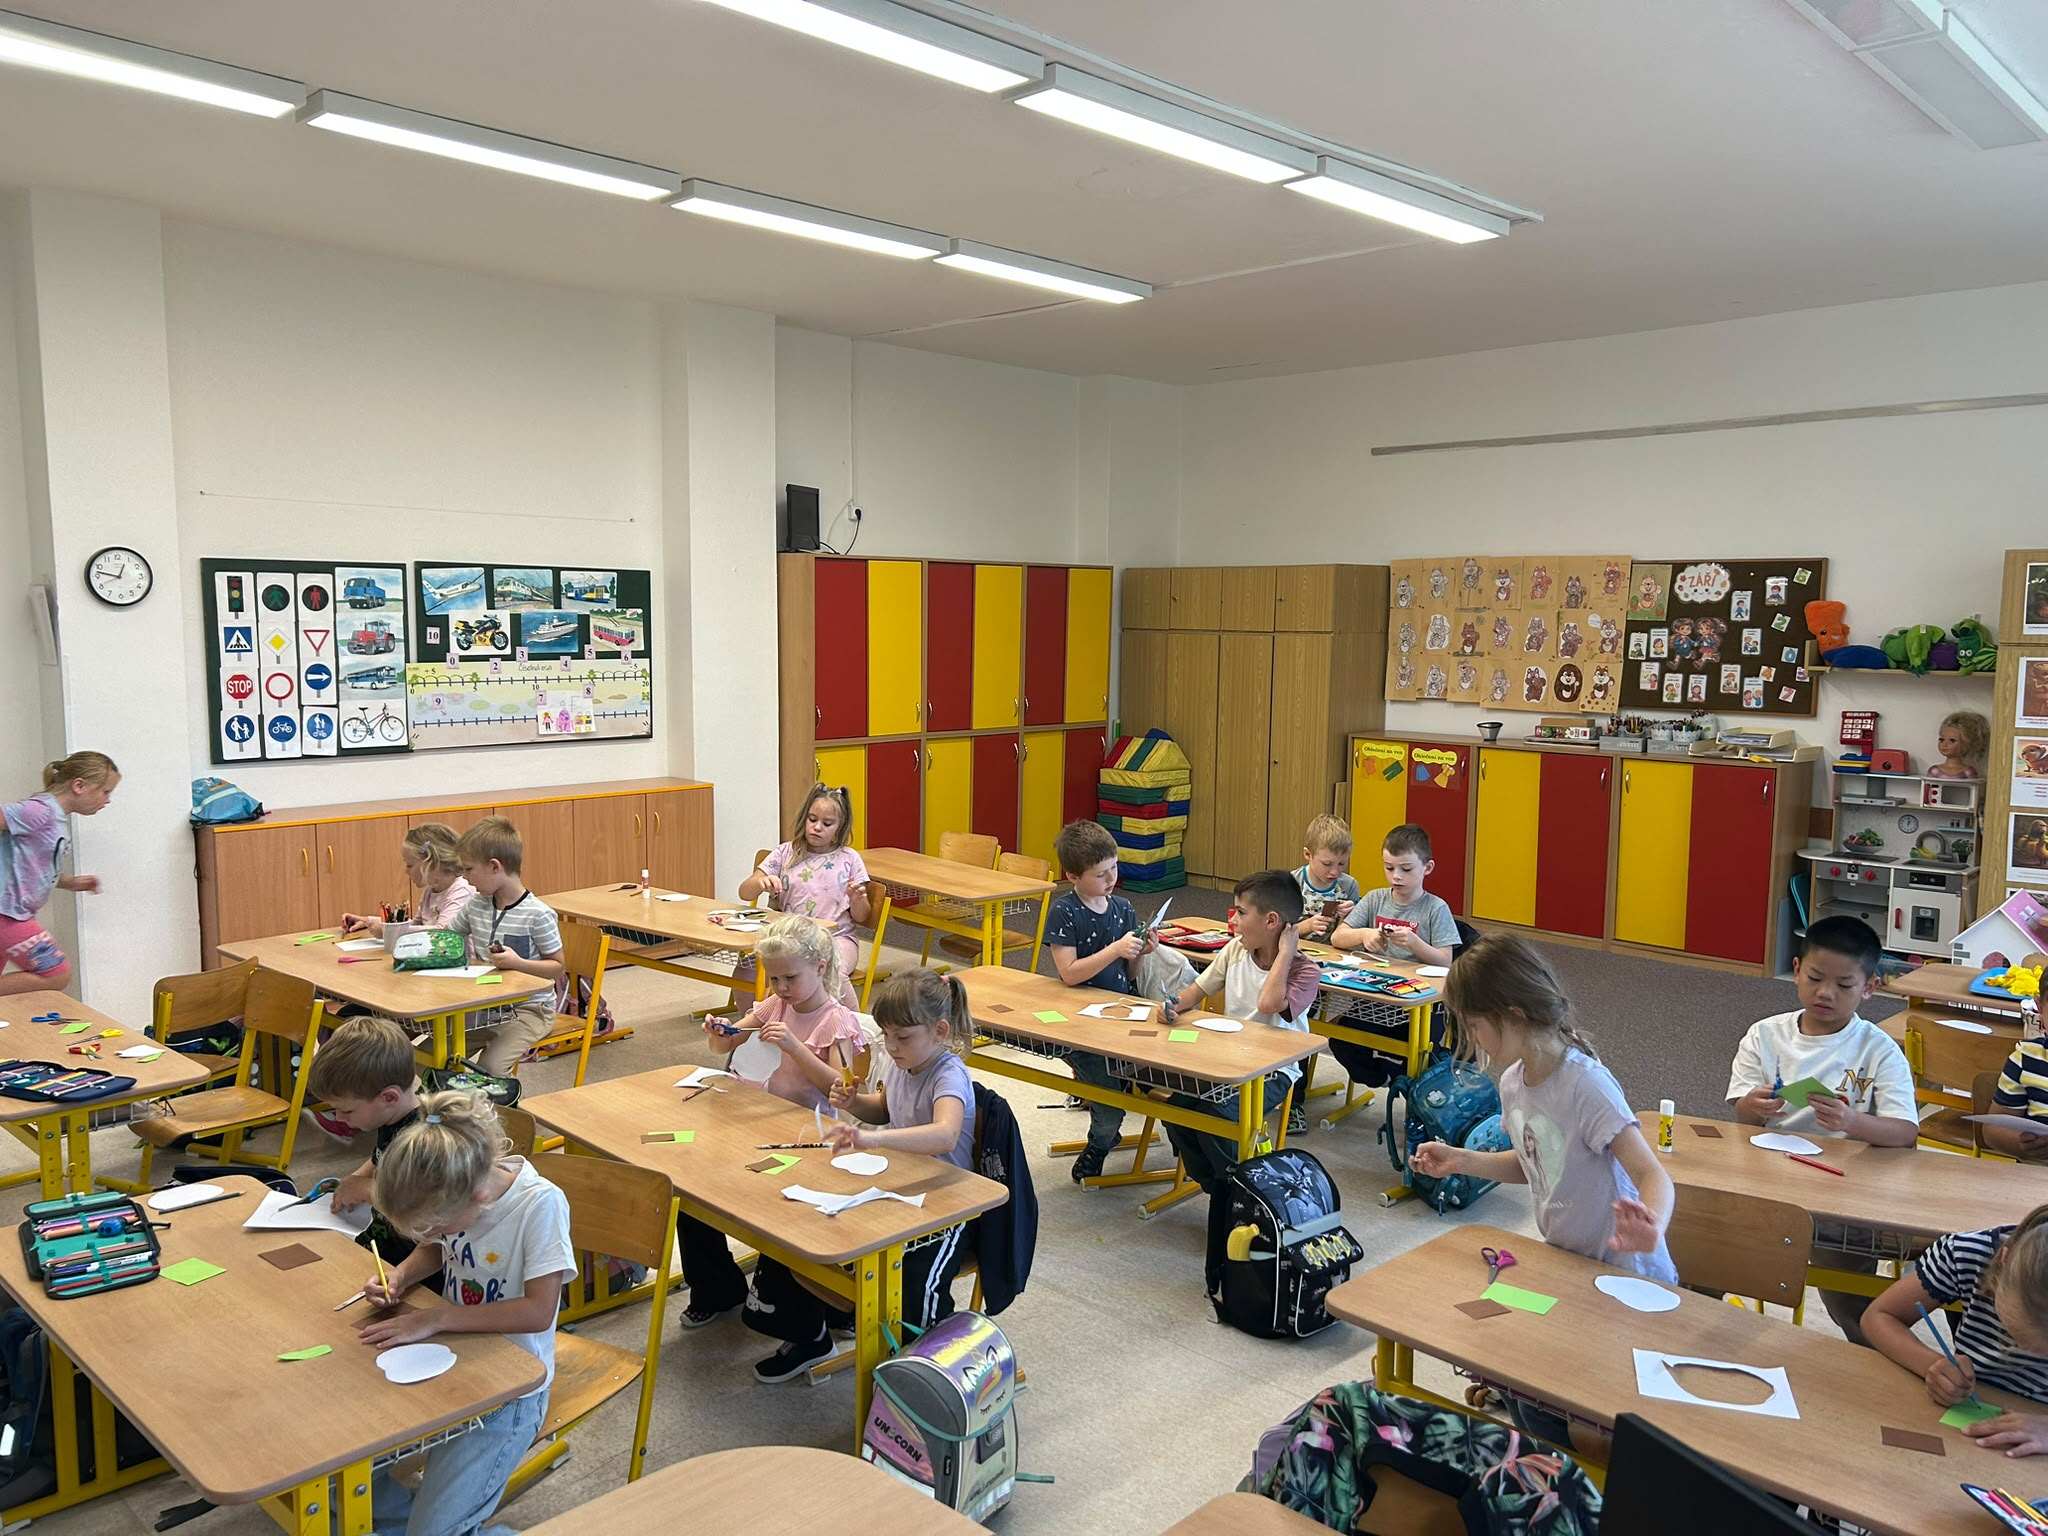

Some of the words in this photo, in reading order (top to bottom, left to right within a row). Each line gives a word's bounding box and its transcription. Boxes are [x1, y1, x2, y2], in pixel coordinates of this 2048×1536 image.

[1687, 570, 1718, 588] ZÁŘÍ
[1774, 616, 1787, 630] 2
[428, 631, 439, 640] 10
[519, 651, 525, 659] 3
[587, 648, 593, 656] 5
[450, 656, 455, 665] 0
[623, 654, 629, 662] 6
[492, 662, 498, 671] 2
[562, 660, 568, 668] 4
[228, 680, 252, 694] STOP
[586, 687, 592, 695] 8
[436, 697, 441, 705] 9
[538, 693, 544, 702] 7
[1835, 1067, 1873, 1103] NY
